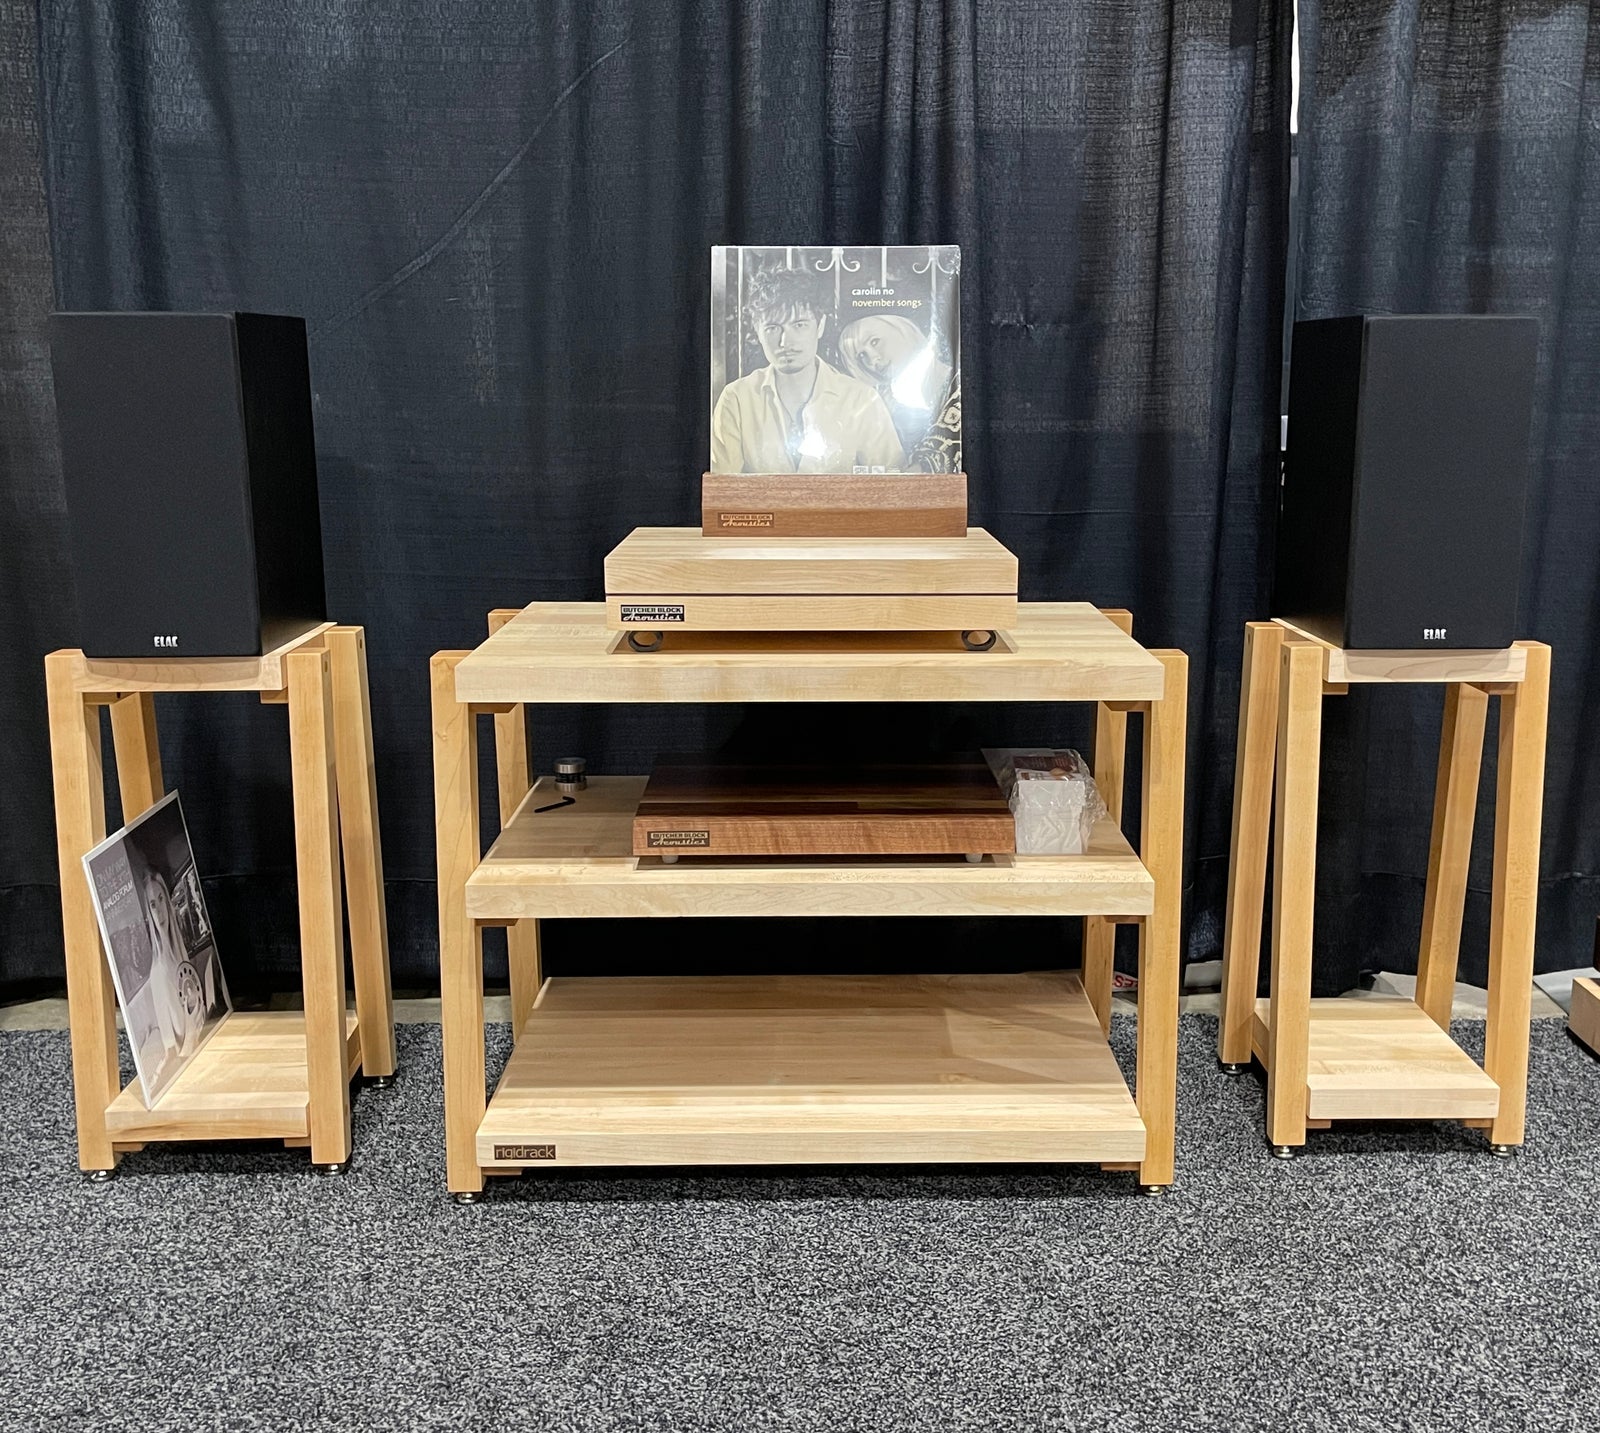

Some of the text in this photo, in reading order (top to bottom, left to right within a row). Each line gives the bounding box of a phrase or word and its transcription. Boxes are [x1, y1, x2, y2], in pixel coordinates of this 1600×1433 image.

[851, 286, 895, 296] carolin no
[852, 299, 922, 309] november songs
[623, 612, 682, 621] Acoustics
[1423, 628, 1447, 640] ELAC
[153, 635, 178, 648] ELAC
[496, 1145, 554, 1160] rigidrack
